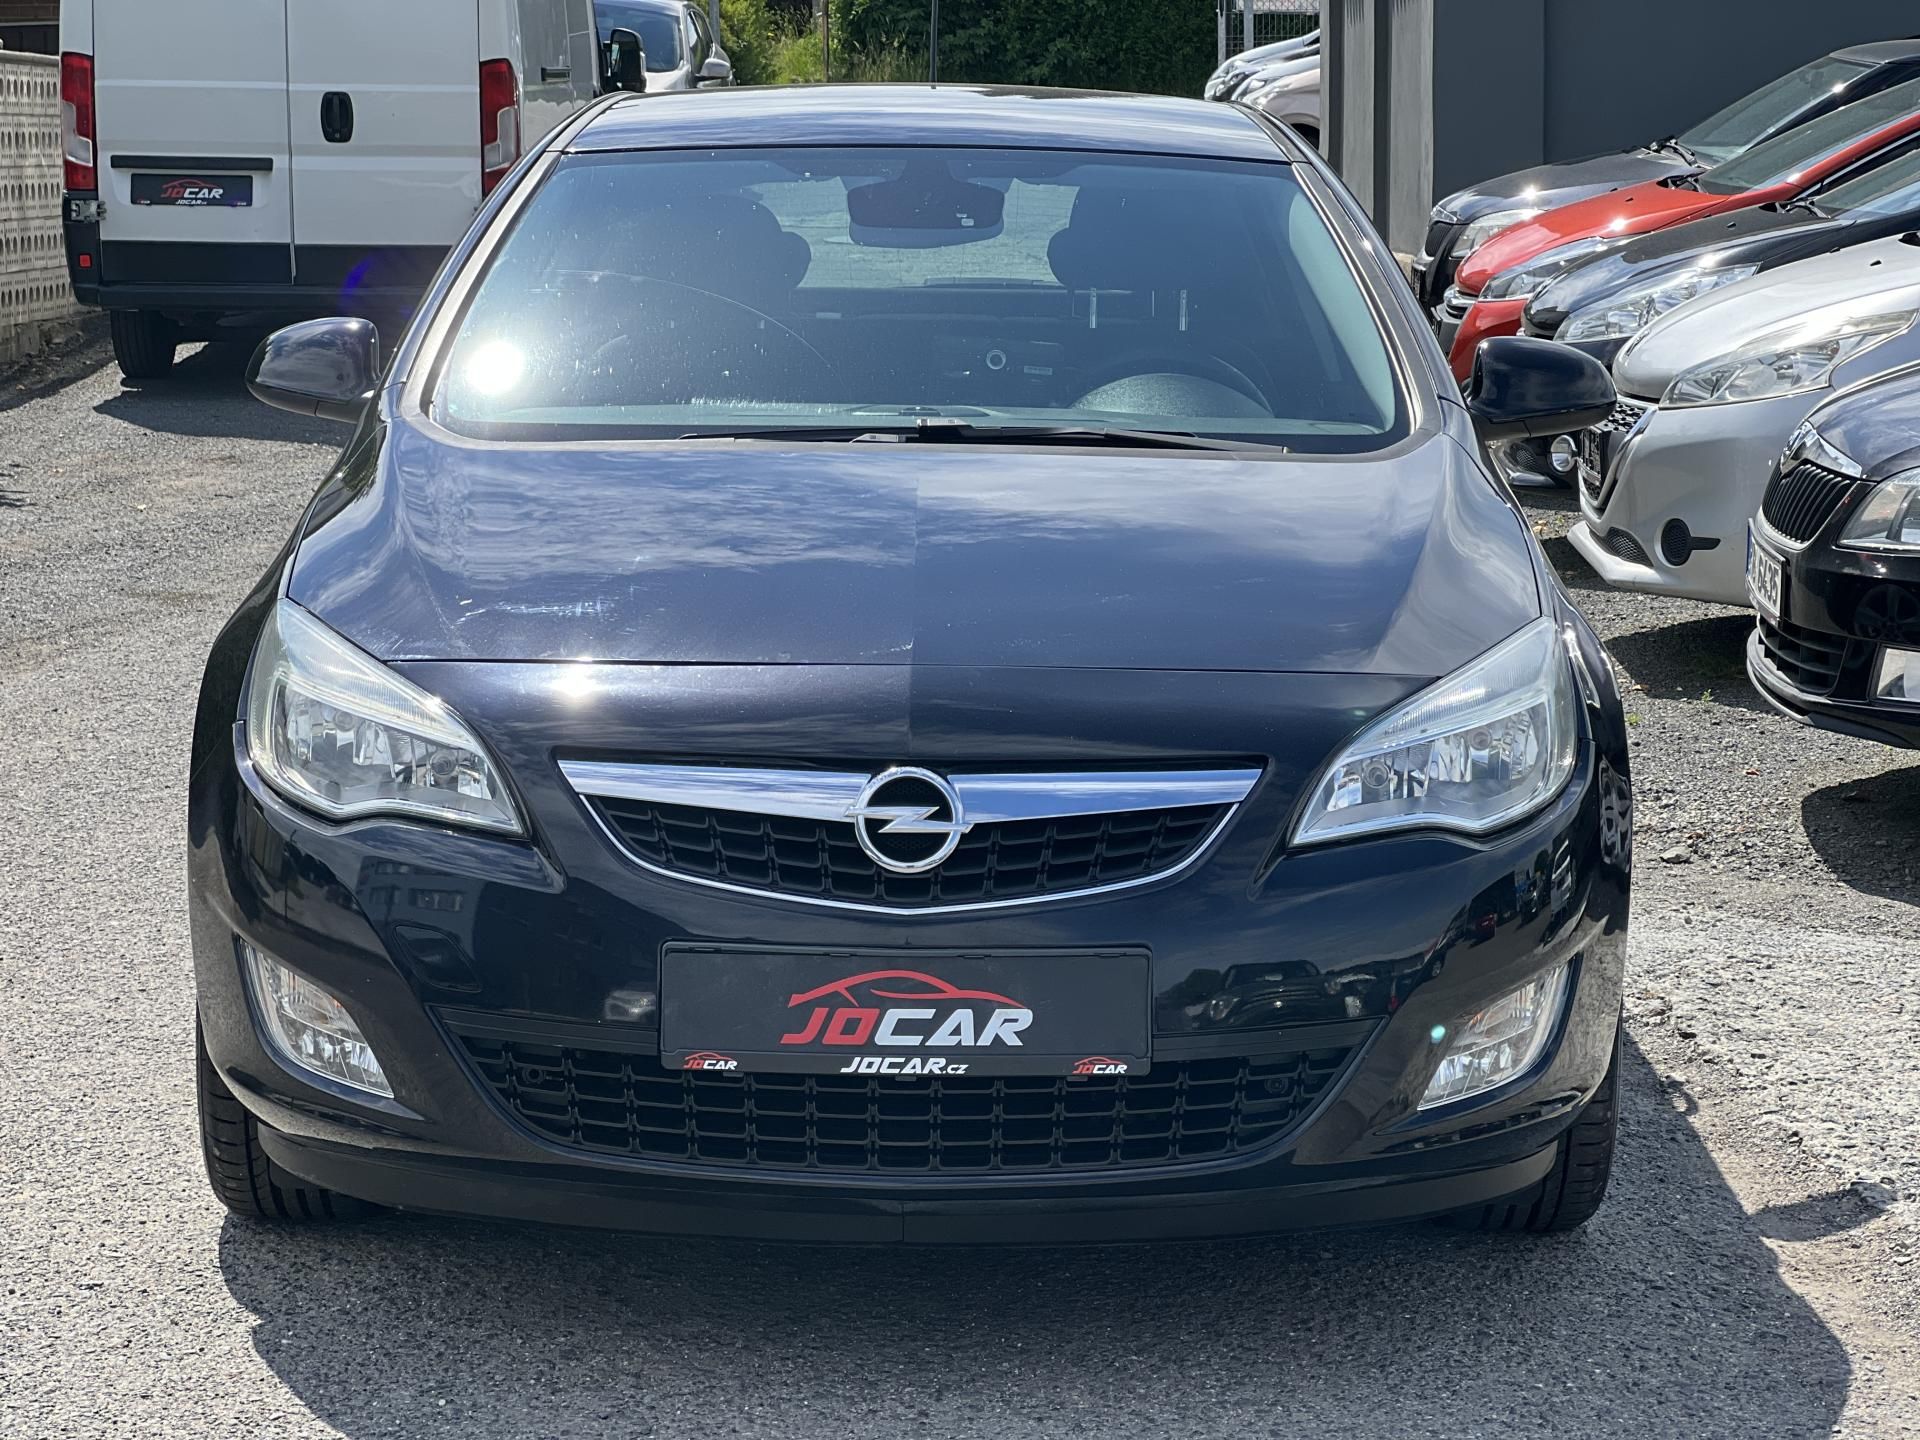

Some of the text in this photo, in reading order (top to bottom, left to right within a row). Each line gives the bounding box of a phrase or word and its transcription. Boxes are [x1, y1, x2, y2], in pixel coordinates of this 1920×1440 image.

[161, 187, 224, 199] JOCAR
[780, 1007, 1034, 1047] JOCAR
[683, 1059, 738, 1071] JOCAR
[1072, 1064, 1128, 1074] JOCAR
